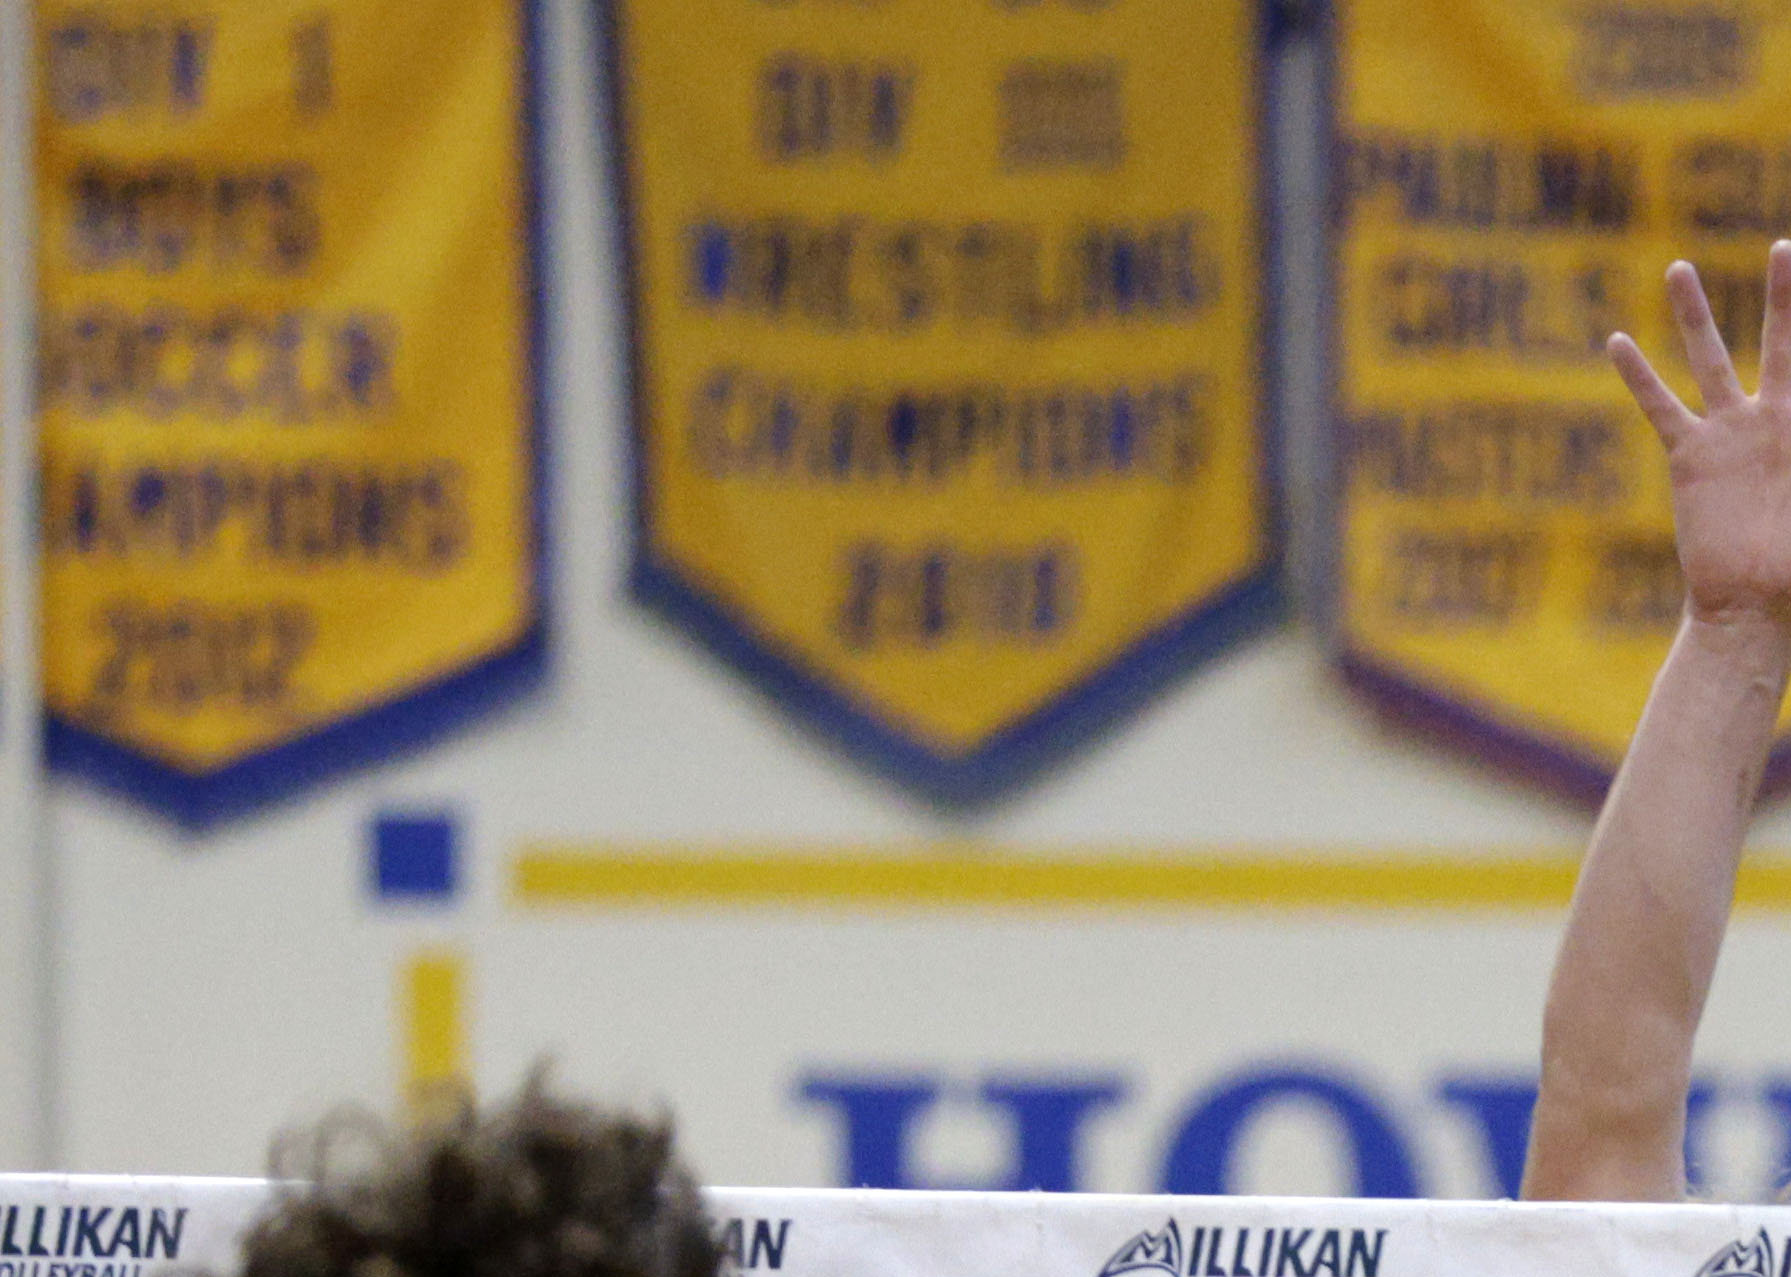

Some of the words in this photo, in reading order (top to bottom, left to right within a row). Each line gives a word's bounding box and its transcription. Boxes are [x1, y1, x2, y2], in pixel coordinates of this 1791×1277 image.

[690, 217, 1217, 334] WRESTLING
[690, 370, 1214, 482] CHAMPIONS
[46, 458, 466, 576] AMPIONS
[0, 1204, 188, 1260] LLIKAN
